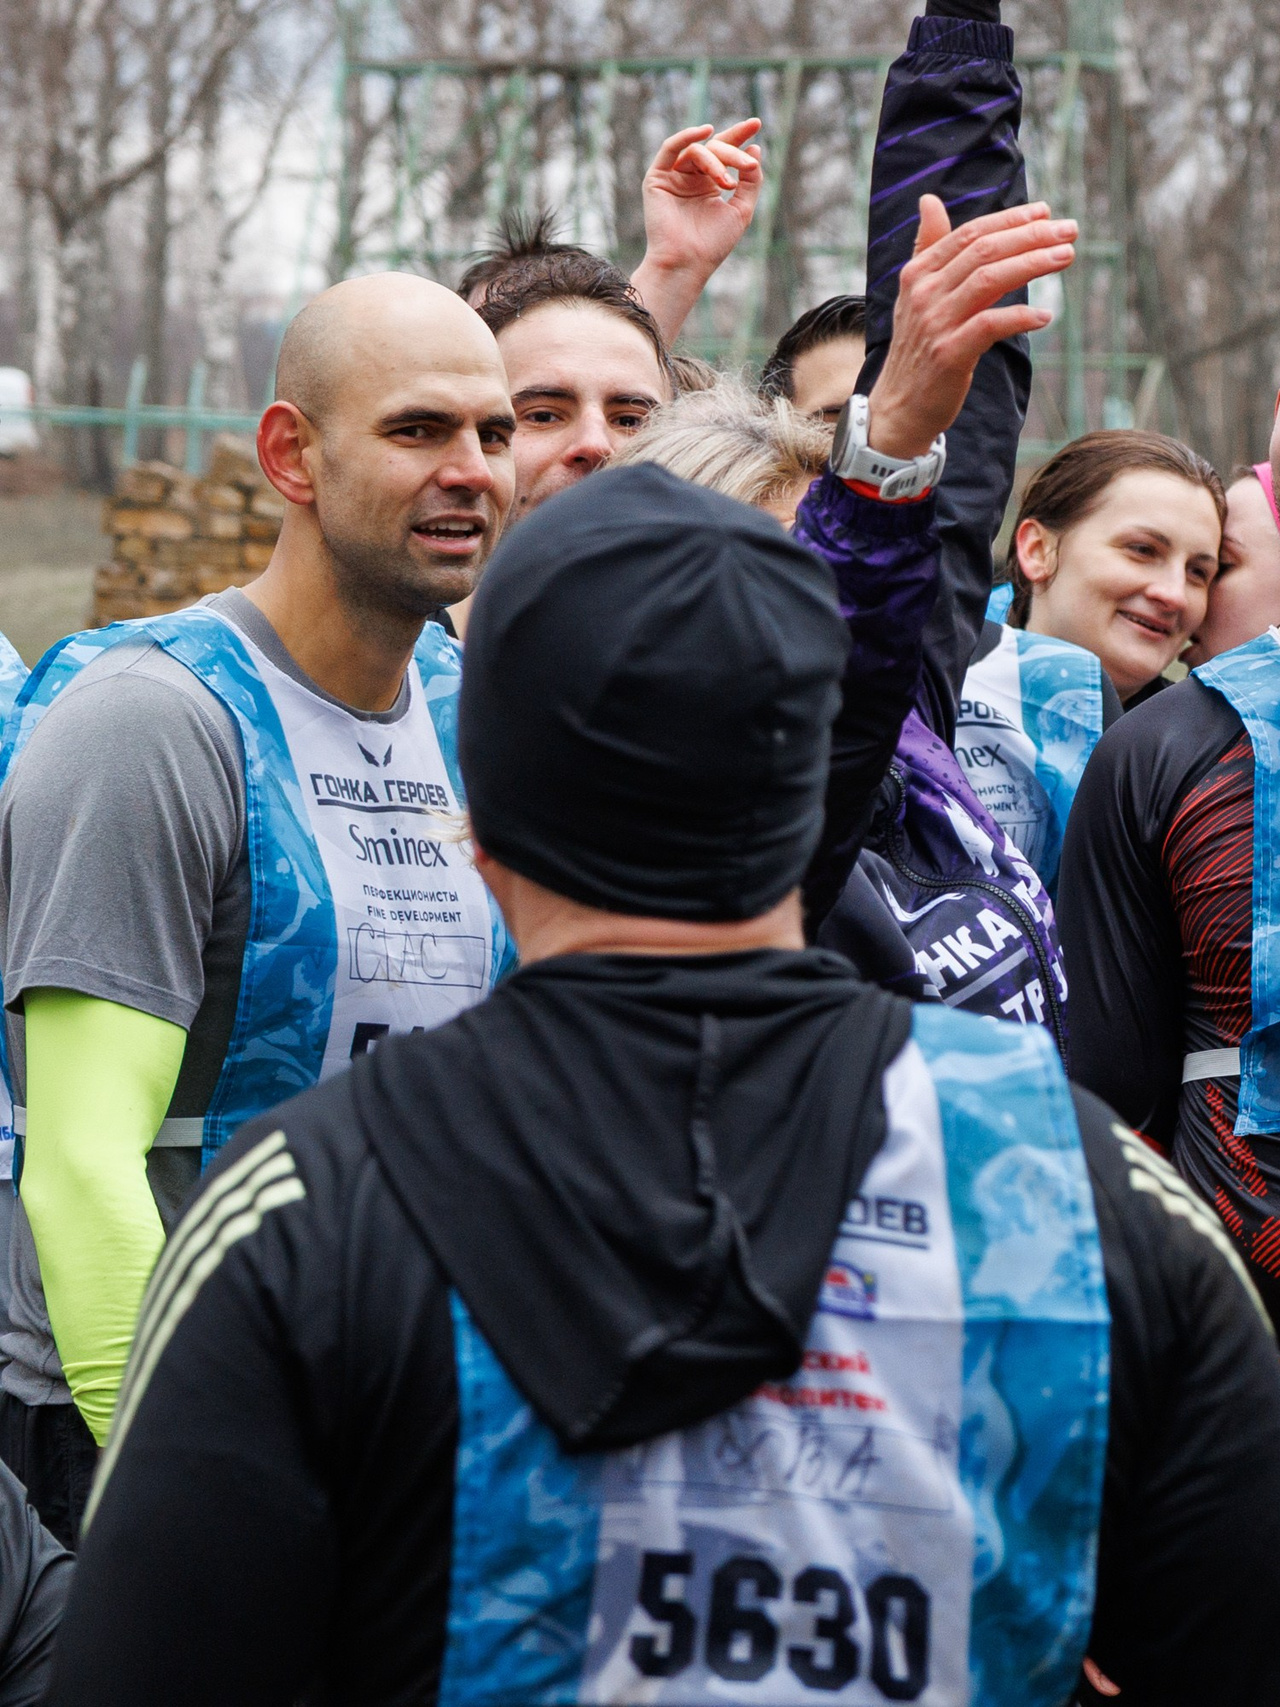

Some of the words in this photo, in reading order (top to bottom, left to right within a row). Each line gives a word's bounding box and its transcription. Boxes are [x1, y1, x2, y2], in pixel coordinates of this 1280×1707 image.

[310, 773, 379, 803] ГОНКА
[383, 779, 450, 807] ГЕРОЕВ
[349, 823, 448, 868] Sminex
[363, 884, 459, 902] ПЕРФЕКЦИОНИСТЫ
[367, 905, 387, 920] FINE
[390, 910, 462, 923] DEVELOPMENT
[356, 922, 449, 983] СТАС
[628, 1550, 931, 1702] 5630
